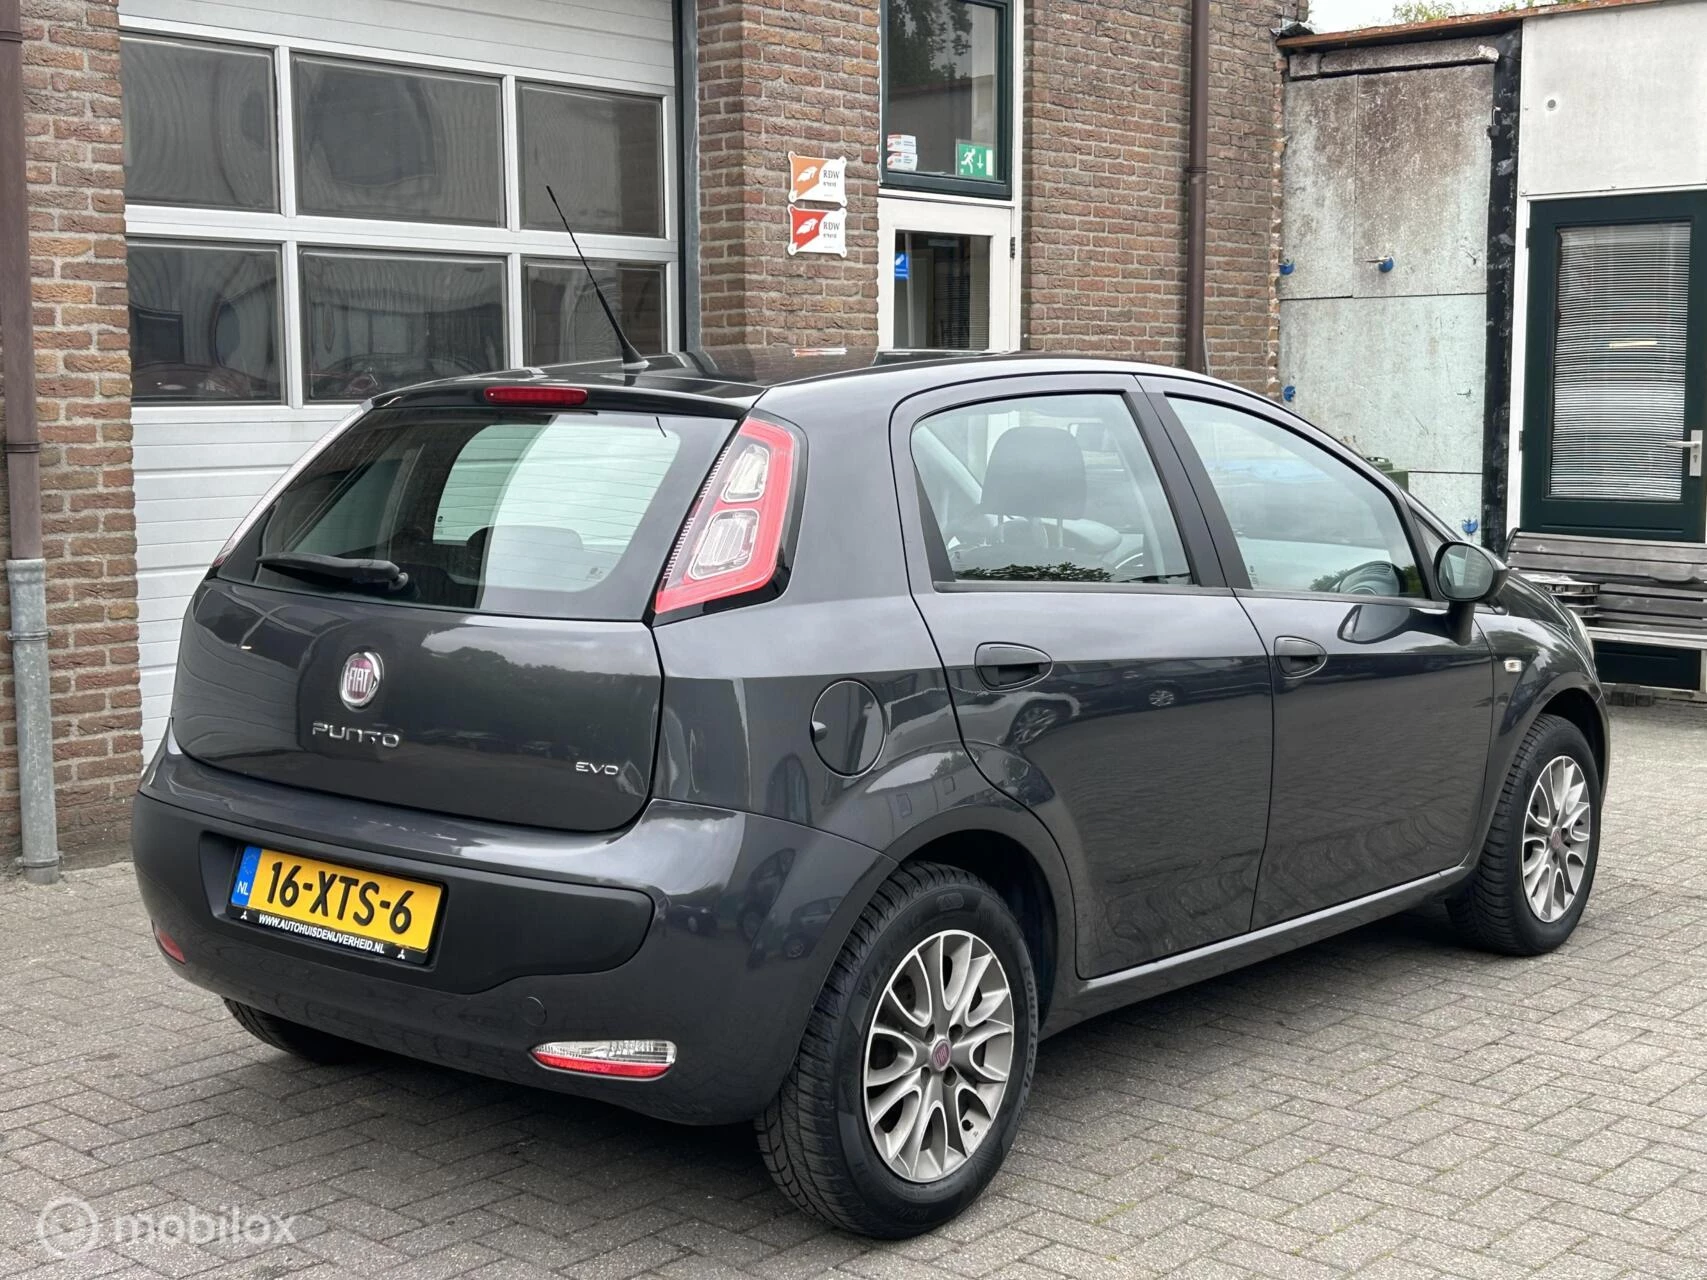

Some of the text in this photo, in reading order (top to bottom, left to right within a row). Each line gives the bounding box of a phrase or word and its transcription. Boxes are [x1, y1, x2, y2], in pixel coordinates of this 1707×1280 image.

[823, 169, 840, 179] RDW
[823, 221, 840, 231] RDW
[347, 667, 371, 692] FIAT
[312, 722, 400, 748] PUNTO
[575, 761, 619, 775] EVO
[237, 881, 249, 896] NL
[266, 861, 414, 935] 16-XTS-6
[258, 913, 385, 954] WWW.AUTOHUISDENIJVERHEID.NL
